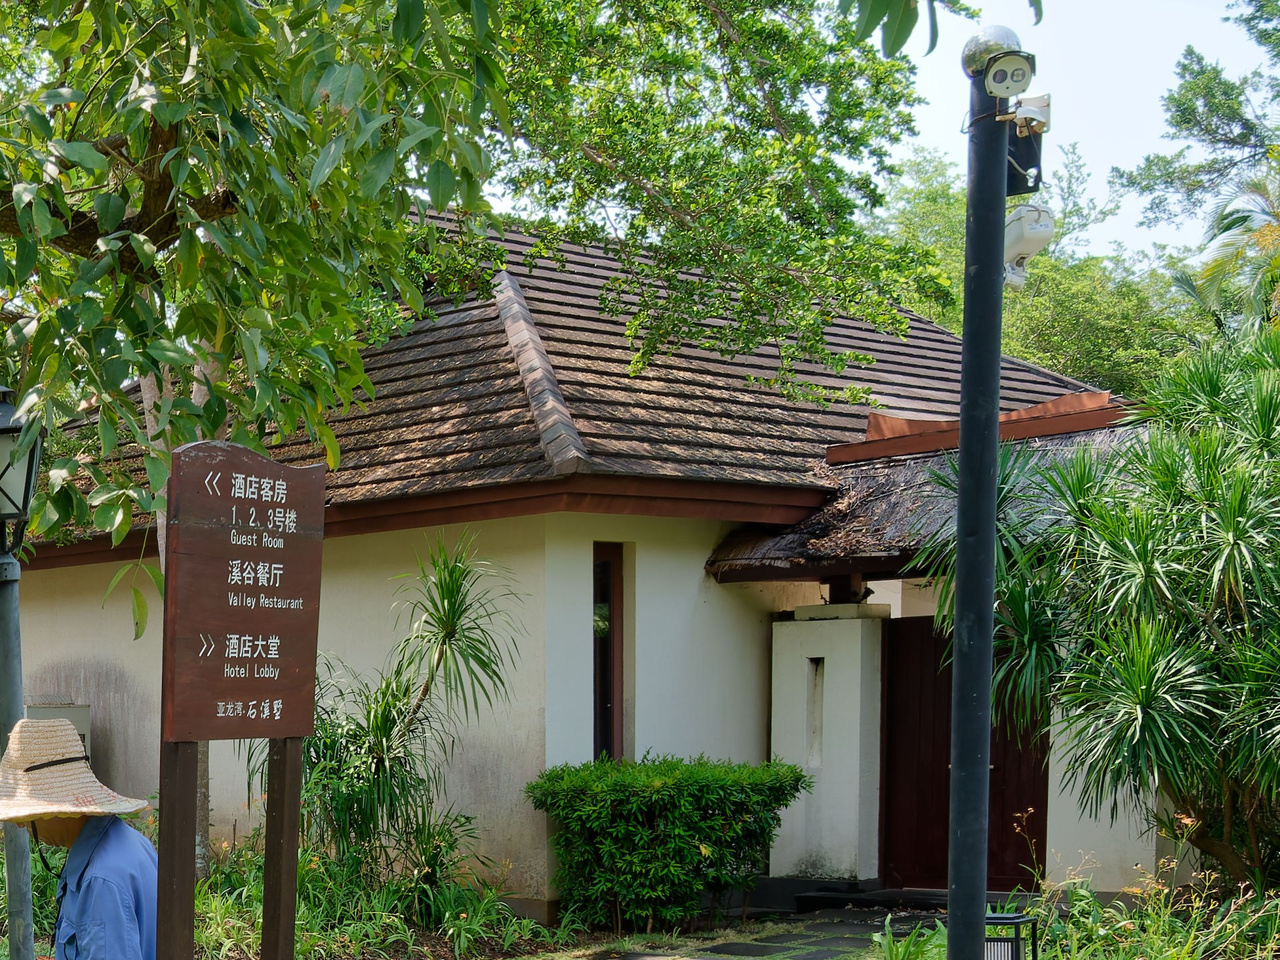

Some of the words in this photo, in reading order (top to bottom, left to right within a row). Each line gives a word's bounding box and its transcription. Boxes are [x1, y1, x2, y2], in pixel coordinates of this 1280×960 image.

[231, 472, 288, 504] 酒店客房
[230, 529, 258, 547] Guest
[262, 532, 284, 549] Room
[227, 560, 284, 587] 溪谷餐厅
[228, 592, 256, 609] Valley
[260, 594, 303, 609] Restaurant
[225, 634, 281, 658] 酒店大堂
[224, 663, 249, 678] Hotel
[254, 664, 280, 680] Lobby
